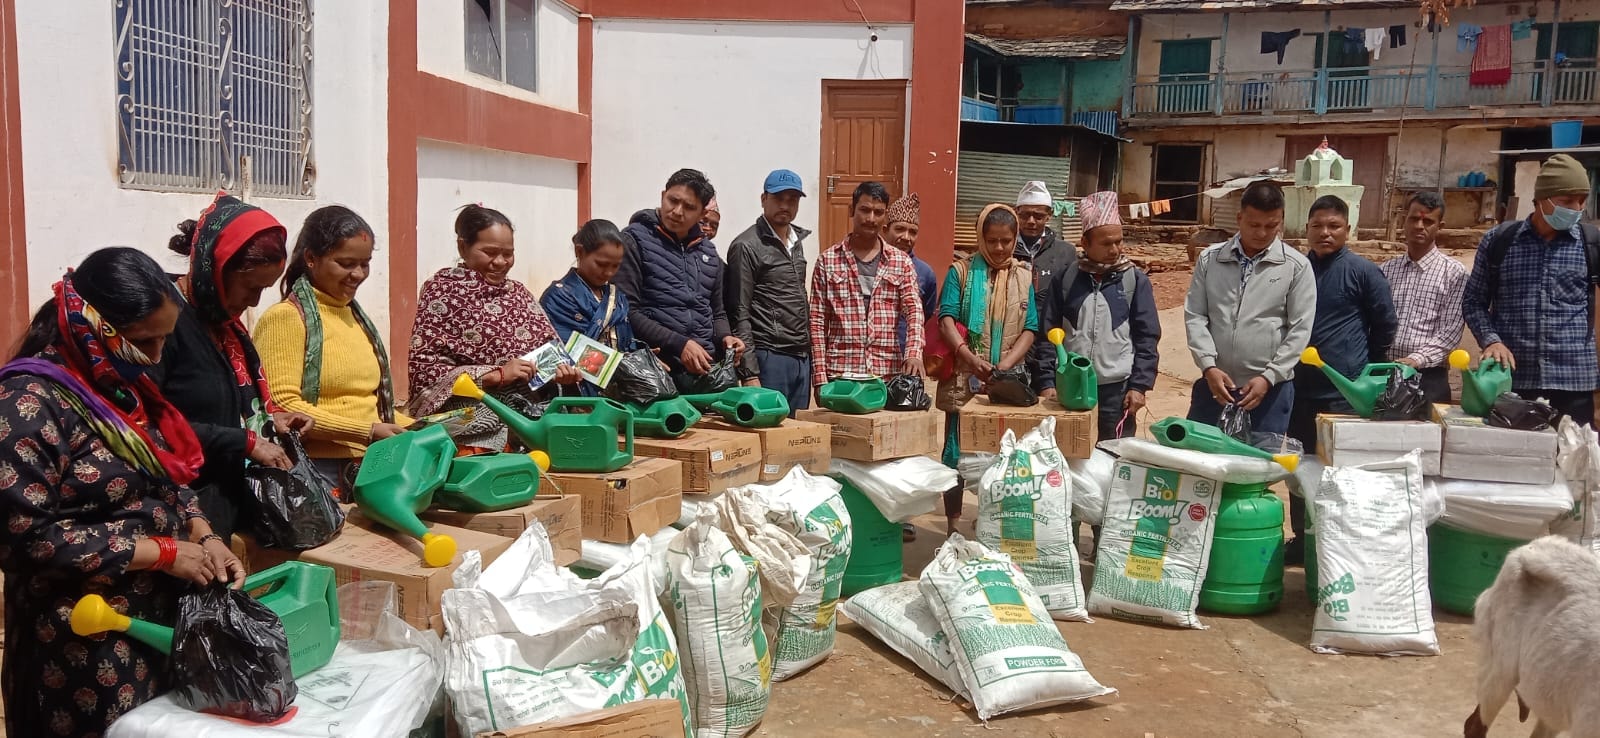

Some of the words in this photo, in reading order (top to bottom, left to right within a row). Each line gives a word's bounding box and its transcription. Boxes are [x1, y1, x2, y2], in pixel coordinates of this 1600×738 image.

[788, 436, 821, 447] NEPTUNE
[725, 447, 752, 461] NEPTUNE
[990, 474, 1046, 504] BOOM!
[990, 511, 1015, 521] ORGANIC
[1127, 498, 1189, 525] BOOM!
[1120, 529, 1147, 538] ORGANIC
[1136, 564, 1151, 572] Crop
[1008, 657, 1045, 667] POWDER
